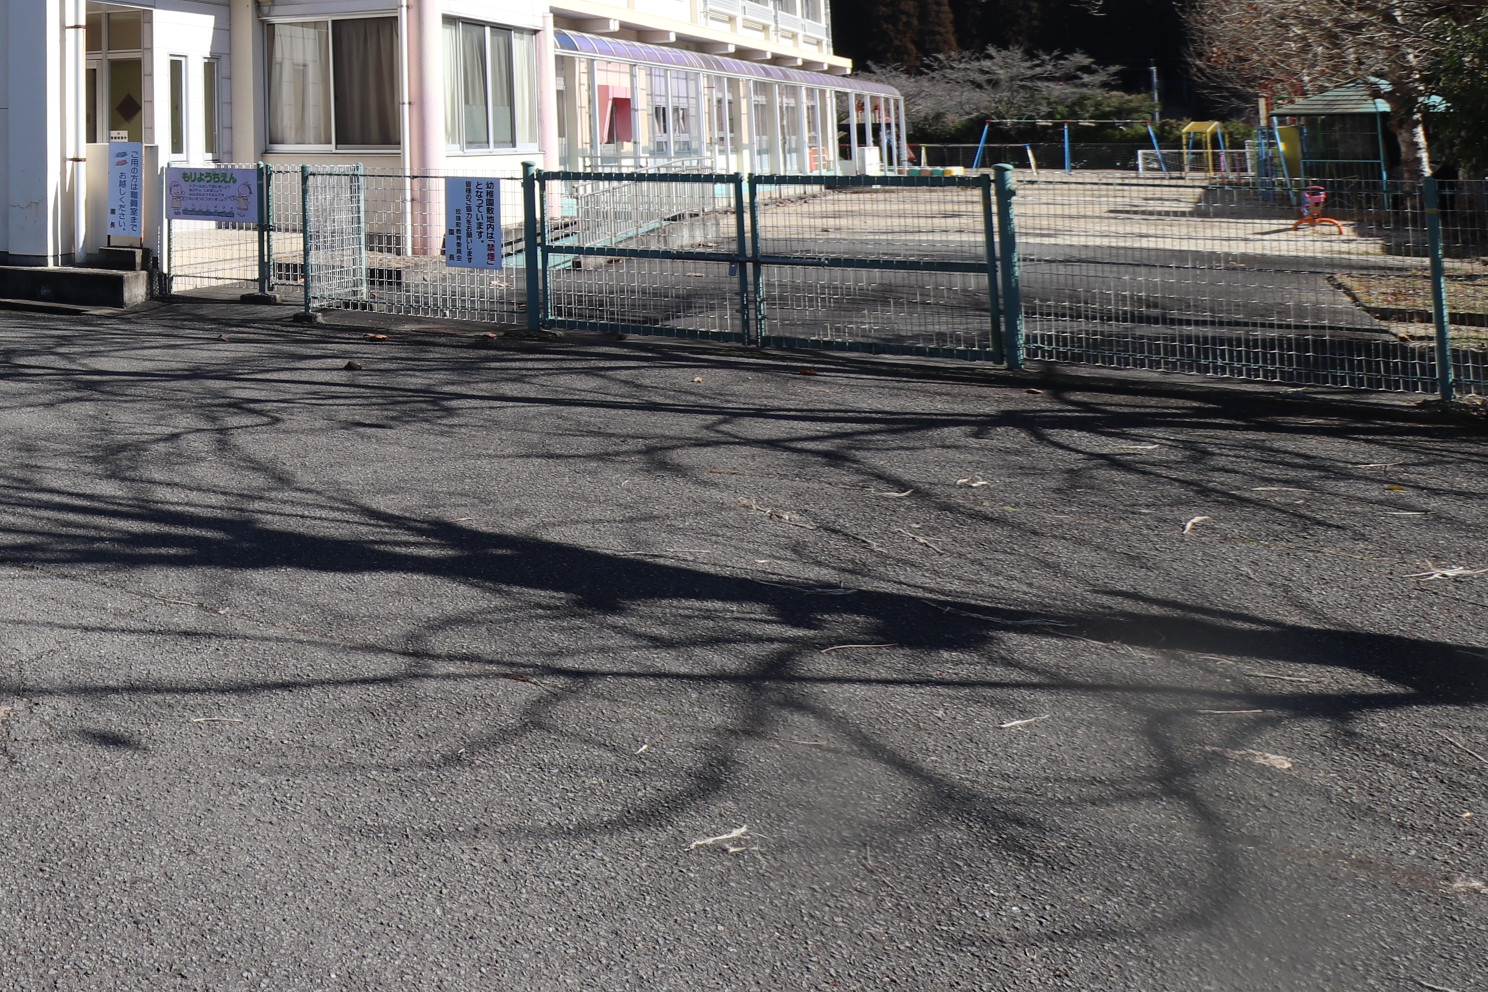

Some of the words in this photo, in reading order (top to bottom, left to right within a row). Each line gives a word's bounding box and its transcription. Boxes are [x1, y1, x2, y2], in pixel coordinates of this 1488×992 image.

[130, 150, 139, 232] ご用の方は職員室まで
[181, 171, 237, 184] もりようちえん
[485, 181, 496, 266] 幼稚園敷地内は「禁煙」
